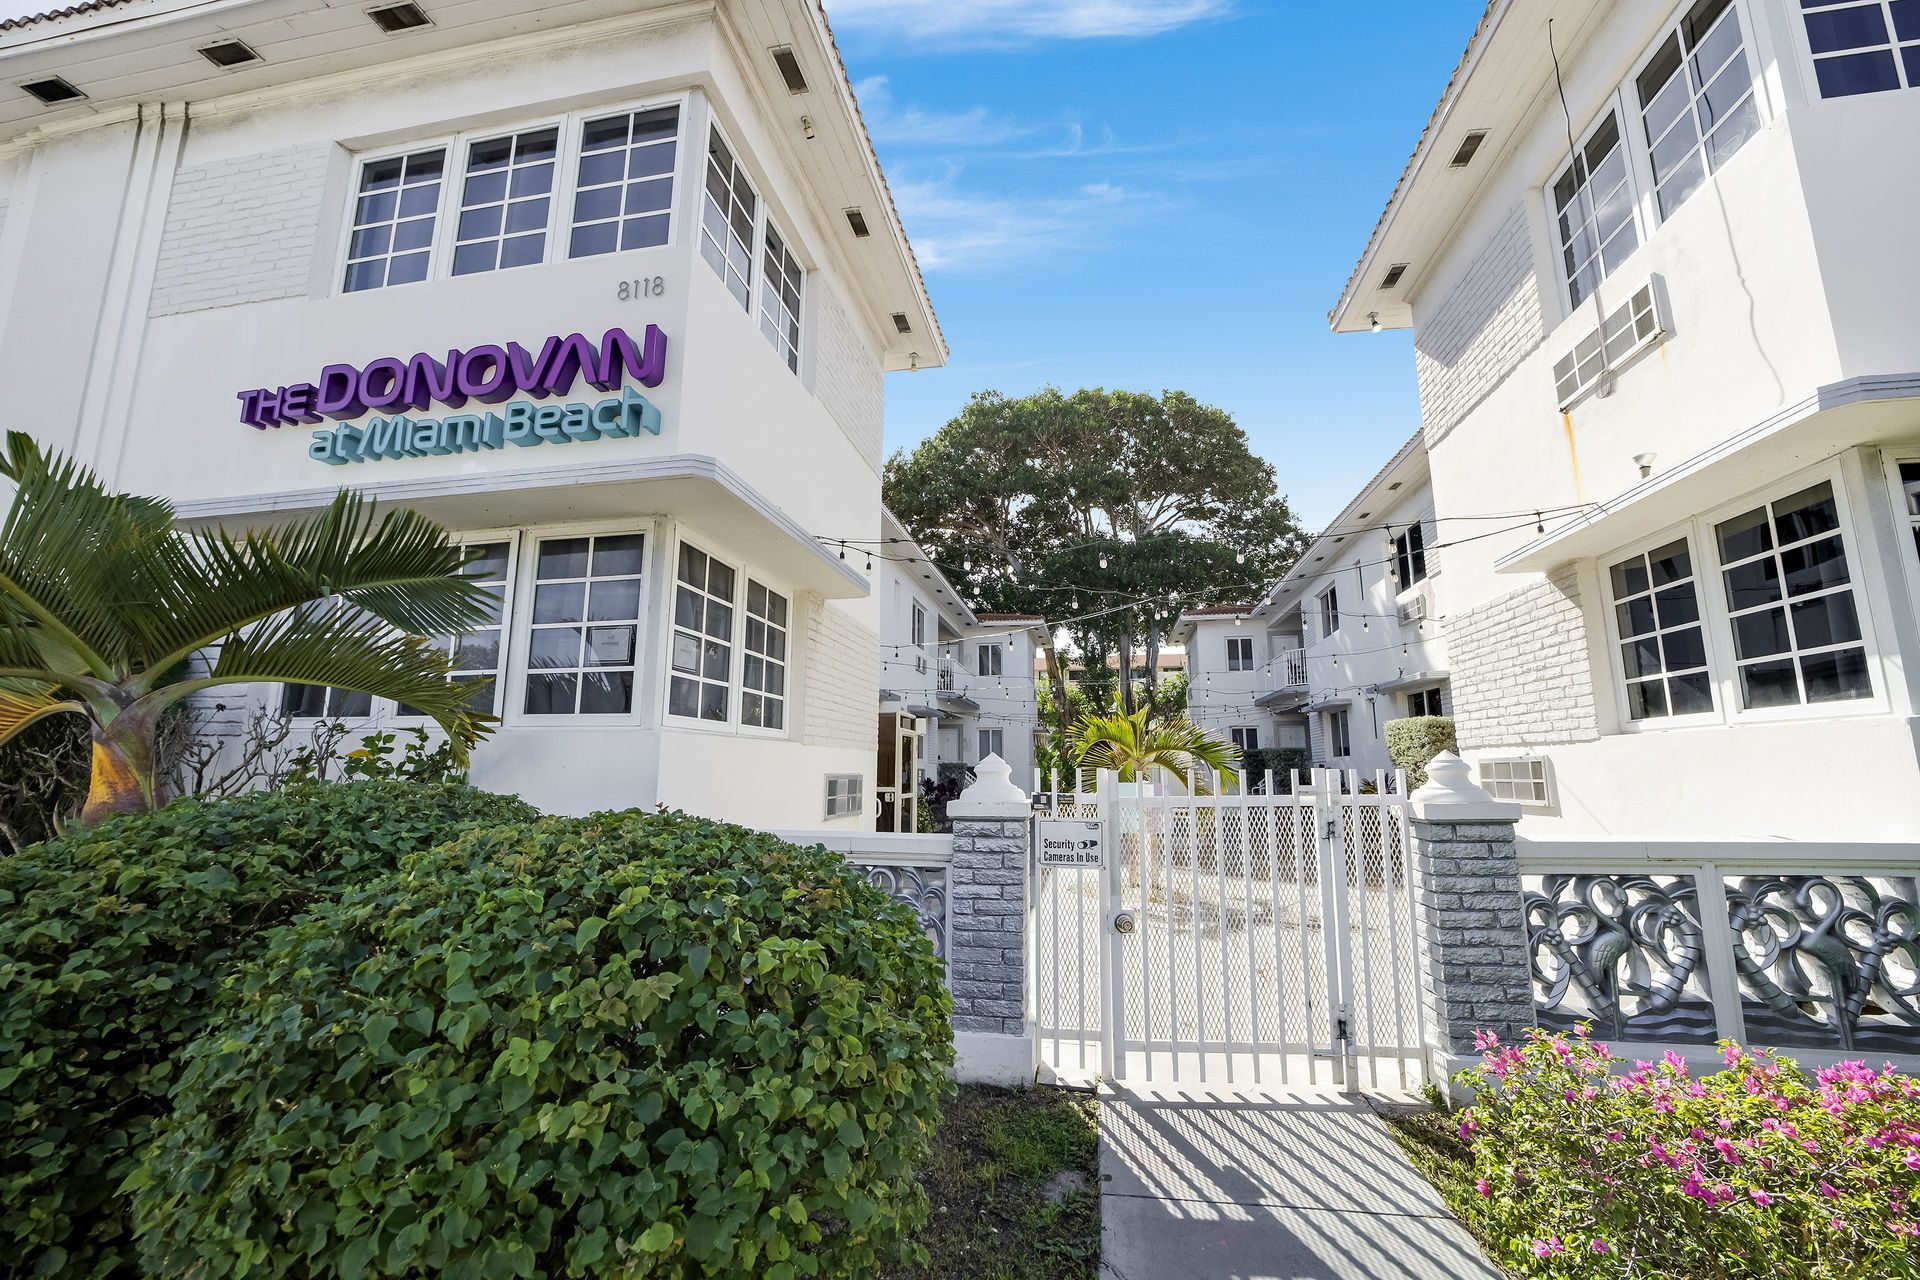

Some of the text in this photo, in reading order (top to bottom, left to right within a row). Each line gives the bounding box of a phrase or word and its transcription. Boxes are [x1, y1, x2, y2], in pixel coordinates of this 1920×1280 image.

[617, 276, 664, 300] 8118
[237, 324, 667, 428] THE DONOVAN
[309, 386, 660, 464] at Miami Beach
[1043, 838, 1075, 851] Security
[1043, 851, 1099, 863] Cameras In Use
